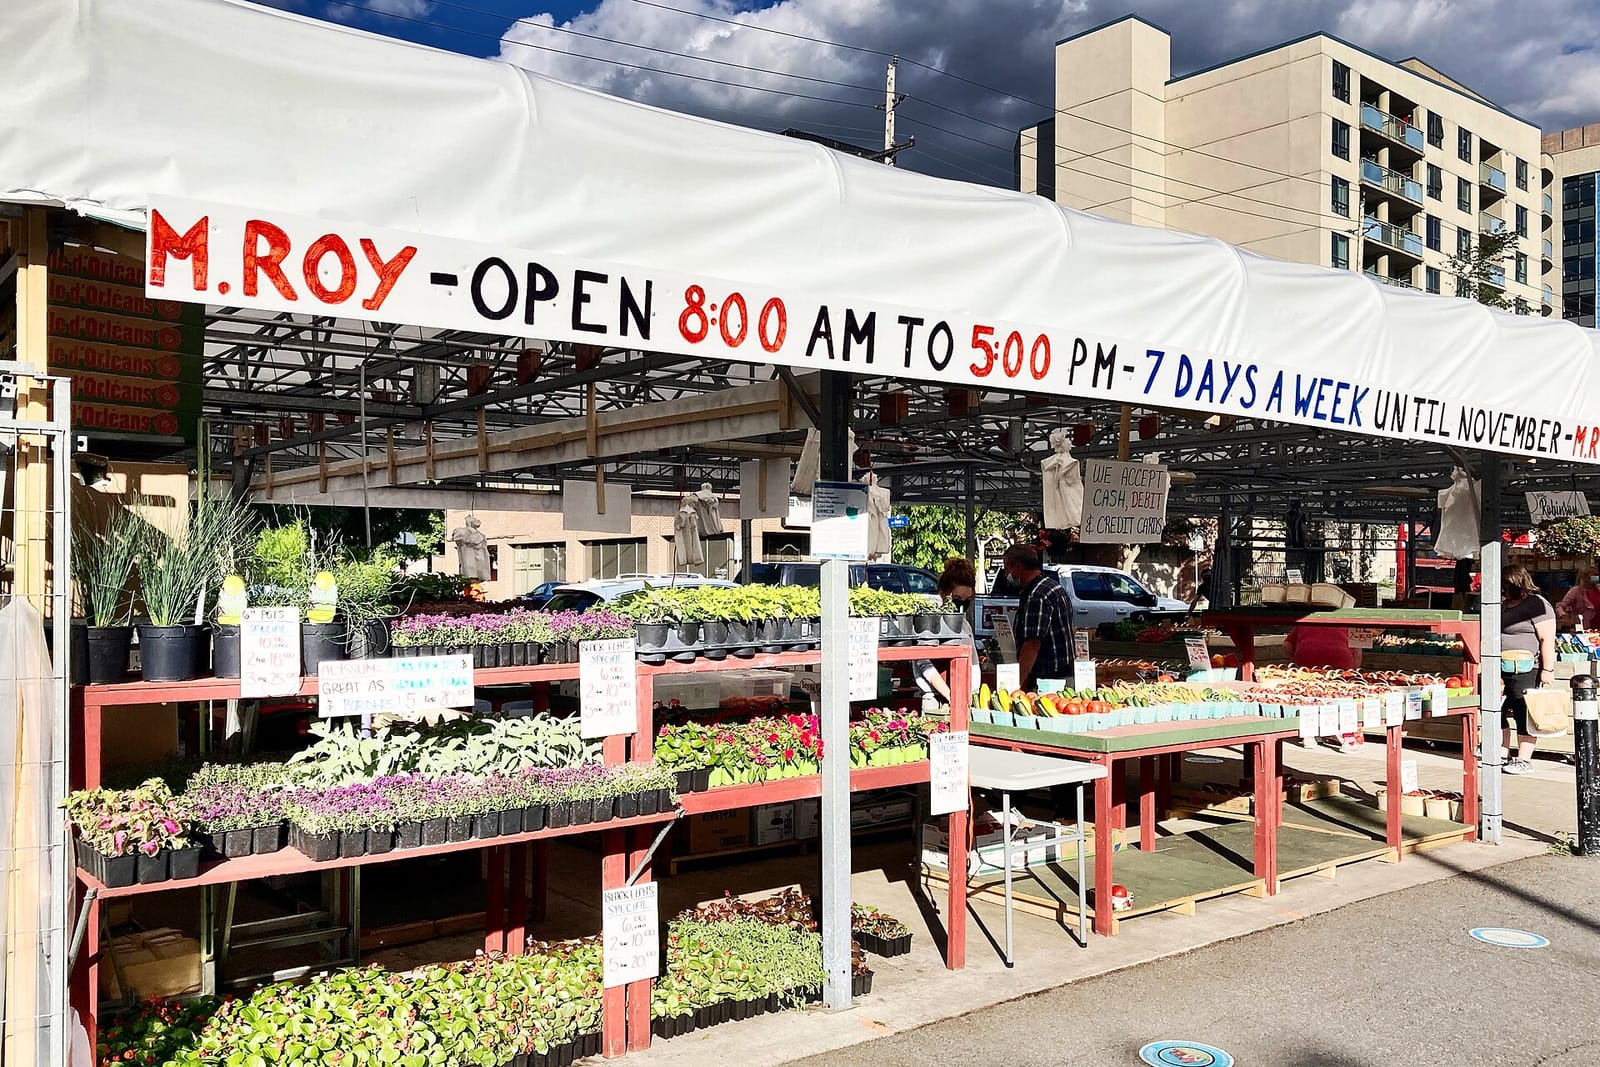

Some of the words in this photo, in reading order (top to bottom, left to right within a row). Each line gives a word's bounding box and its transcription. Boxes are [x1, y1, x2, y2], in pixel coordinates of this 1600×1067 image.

[149, 208, 417, 311] M.ROY
[678, 284, 788, 353] 8:00
[805, 305, 876, 364] AM
[897, 315, 954, 371] TO
[968, 325, 1051, 381] 5:00
[1174, 354, 1259, 409] DAYS
[1265, 370, 1284, 413] A
[1294, 373, 1370, 427] WEEK
[1374, 389, 1450, 437] UNTIL
[1092, 464, 1113, 484] WE
[1121, 467, 1165, 489] ACCEPT
[1093, 488, 1129, 511] CASH,
[1131, 491, 1164, 511] DEBIT
[1096, 515, 1135, 535] CREDIT
[322, 682, 360, 696] GREAT
[368, 680, 385, 692] AS
